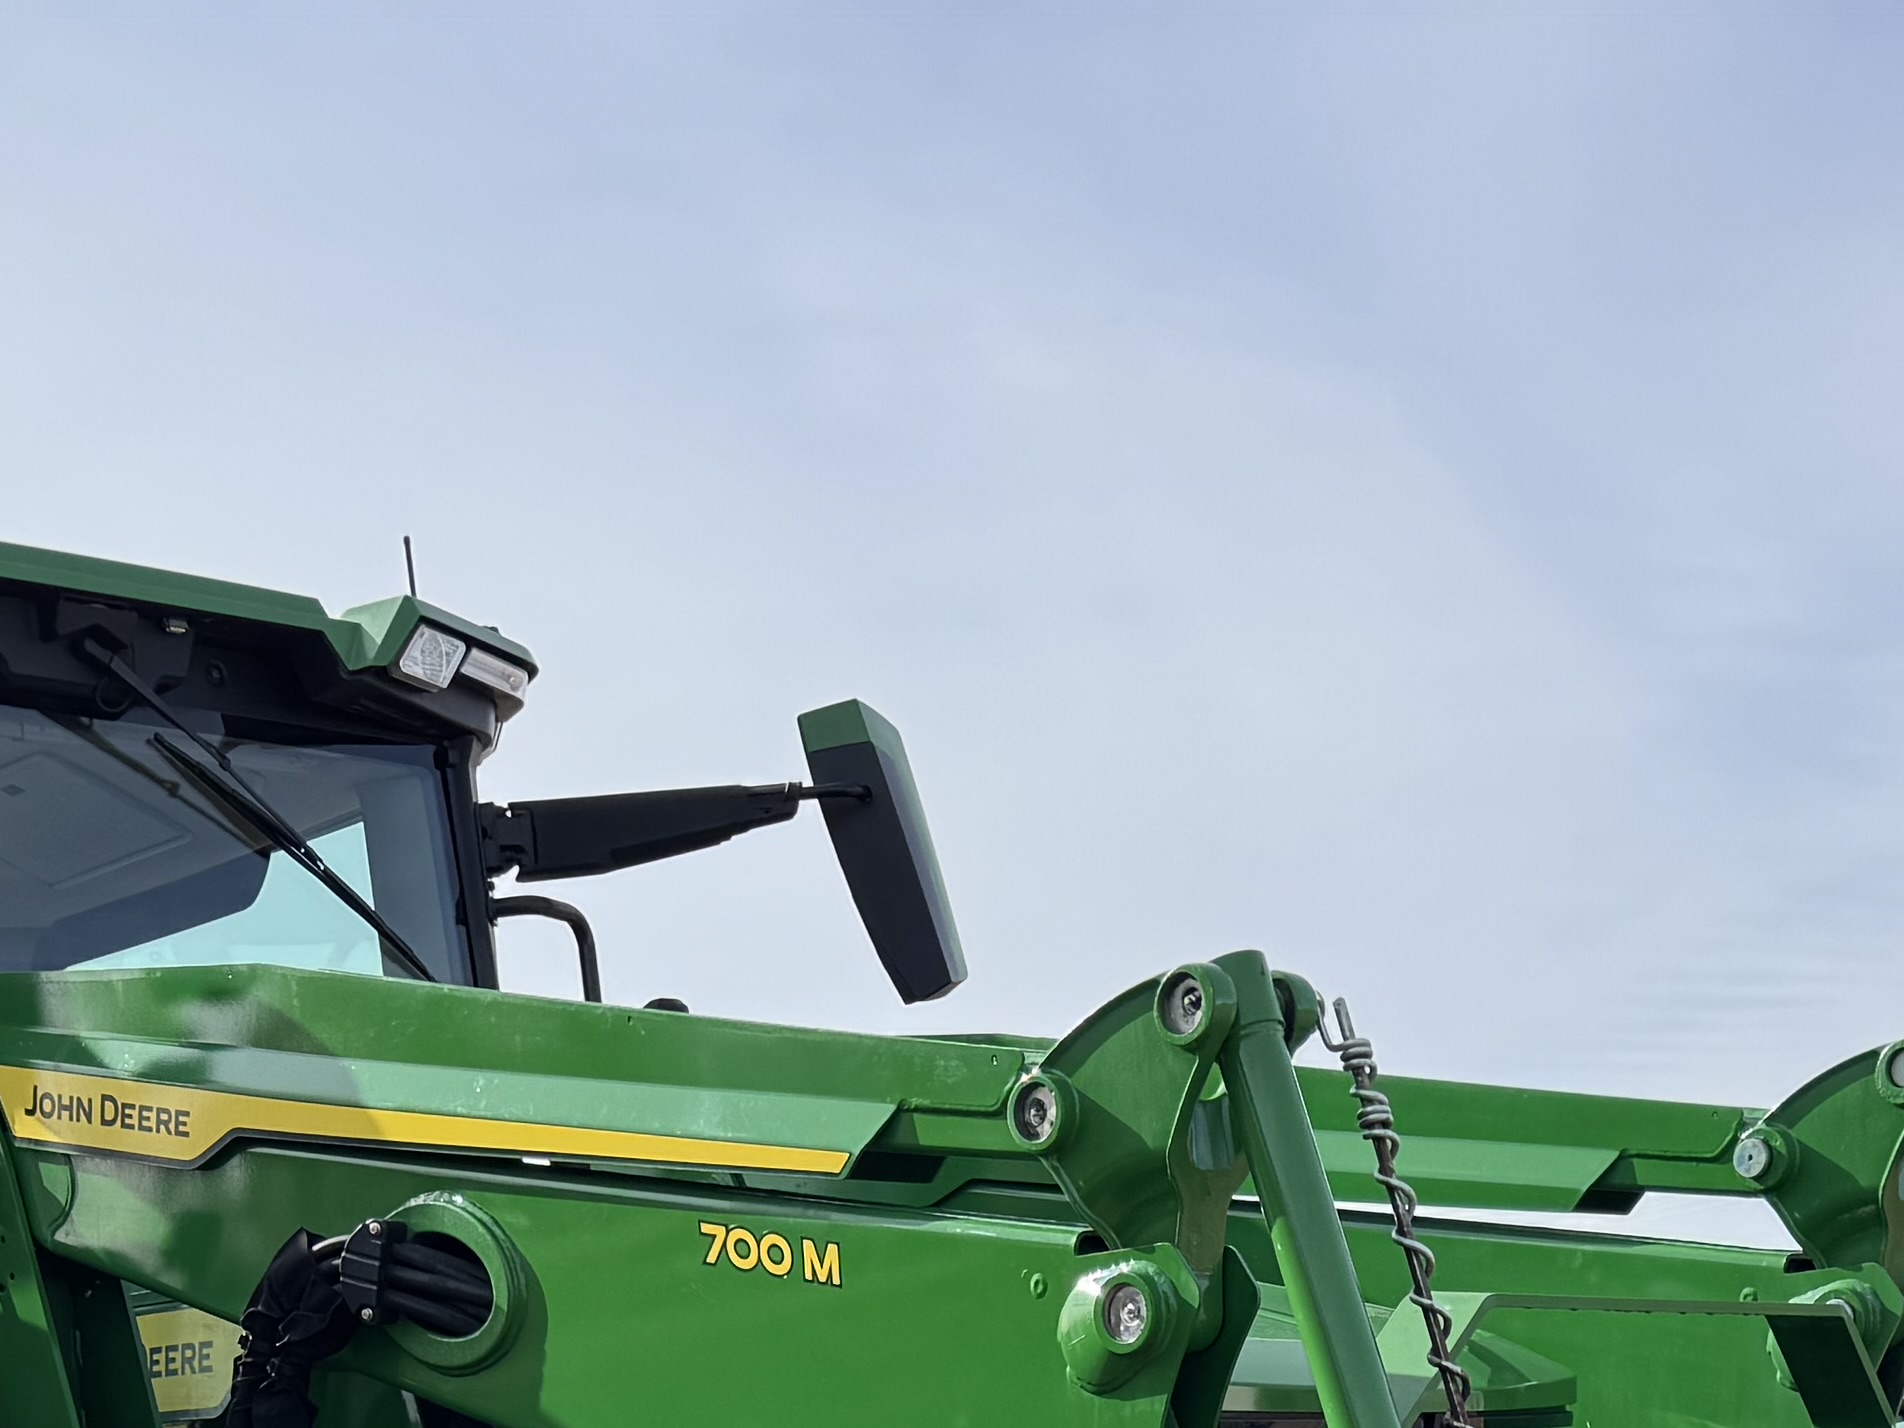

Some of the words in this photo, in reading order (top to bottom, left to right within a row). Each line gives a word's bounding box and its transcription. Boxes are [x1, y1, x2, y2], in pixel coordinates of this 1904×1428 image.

[24, 1085, 93, 1125] JOHN
[100, 1094, 191, 1137] DEERE
[698, 1220, 793, 1278] 700
[801, 1236, 842, 1288] M
[148, 1340, 213, 1378] EERE
